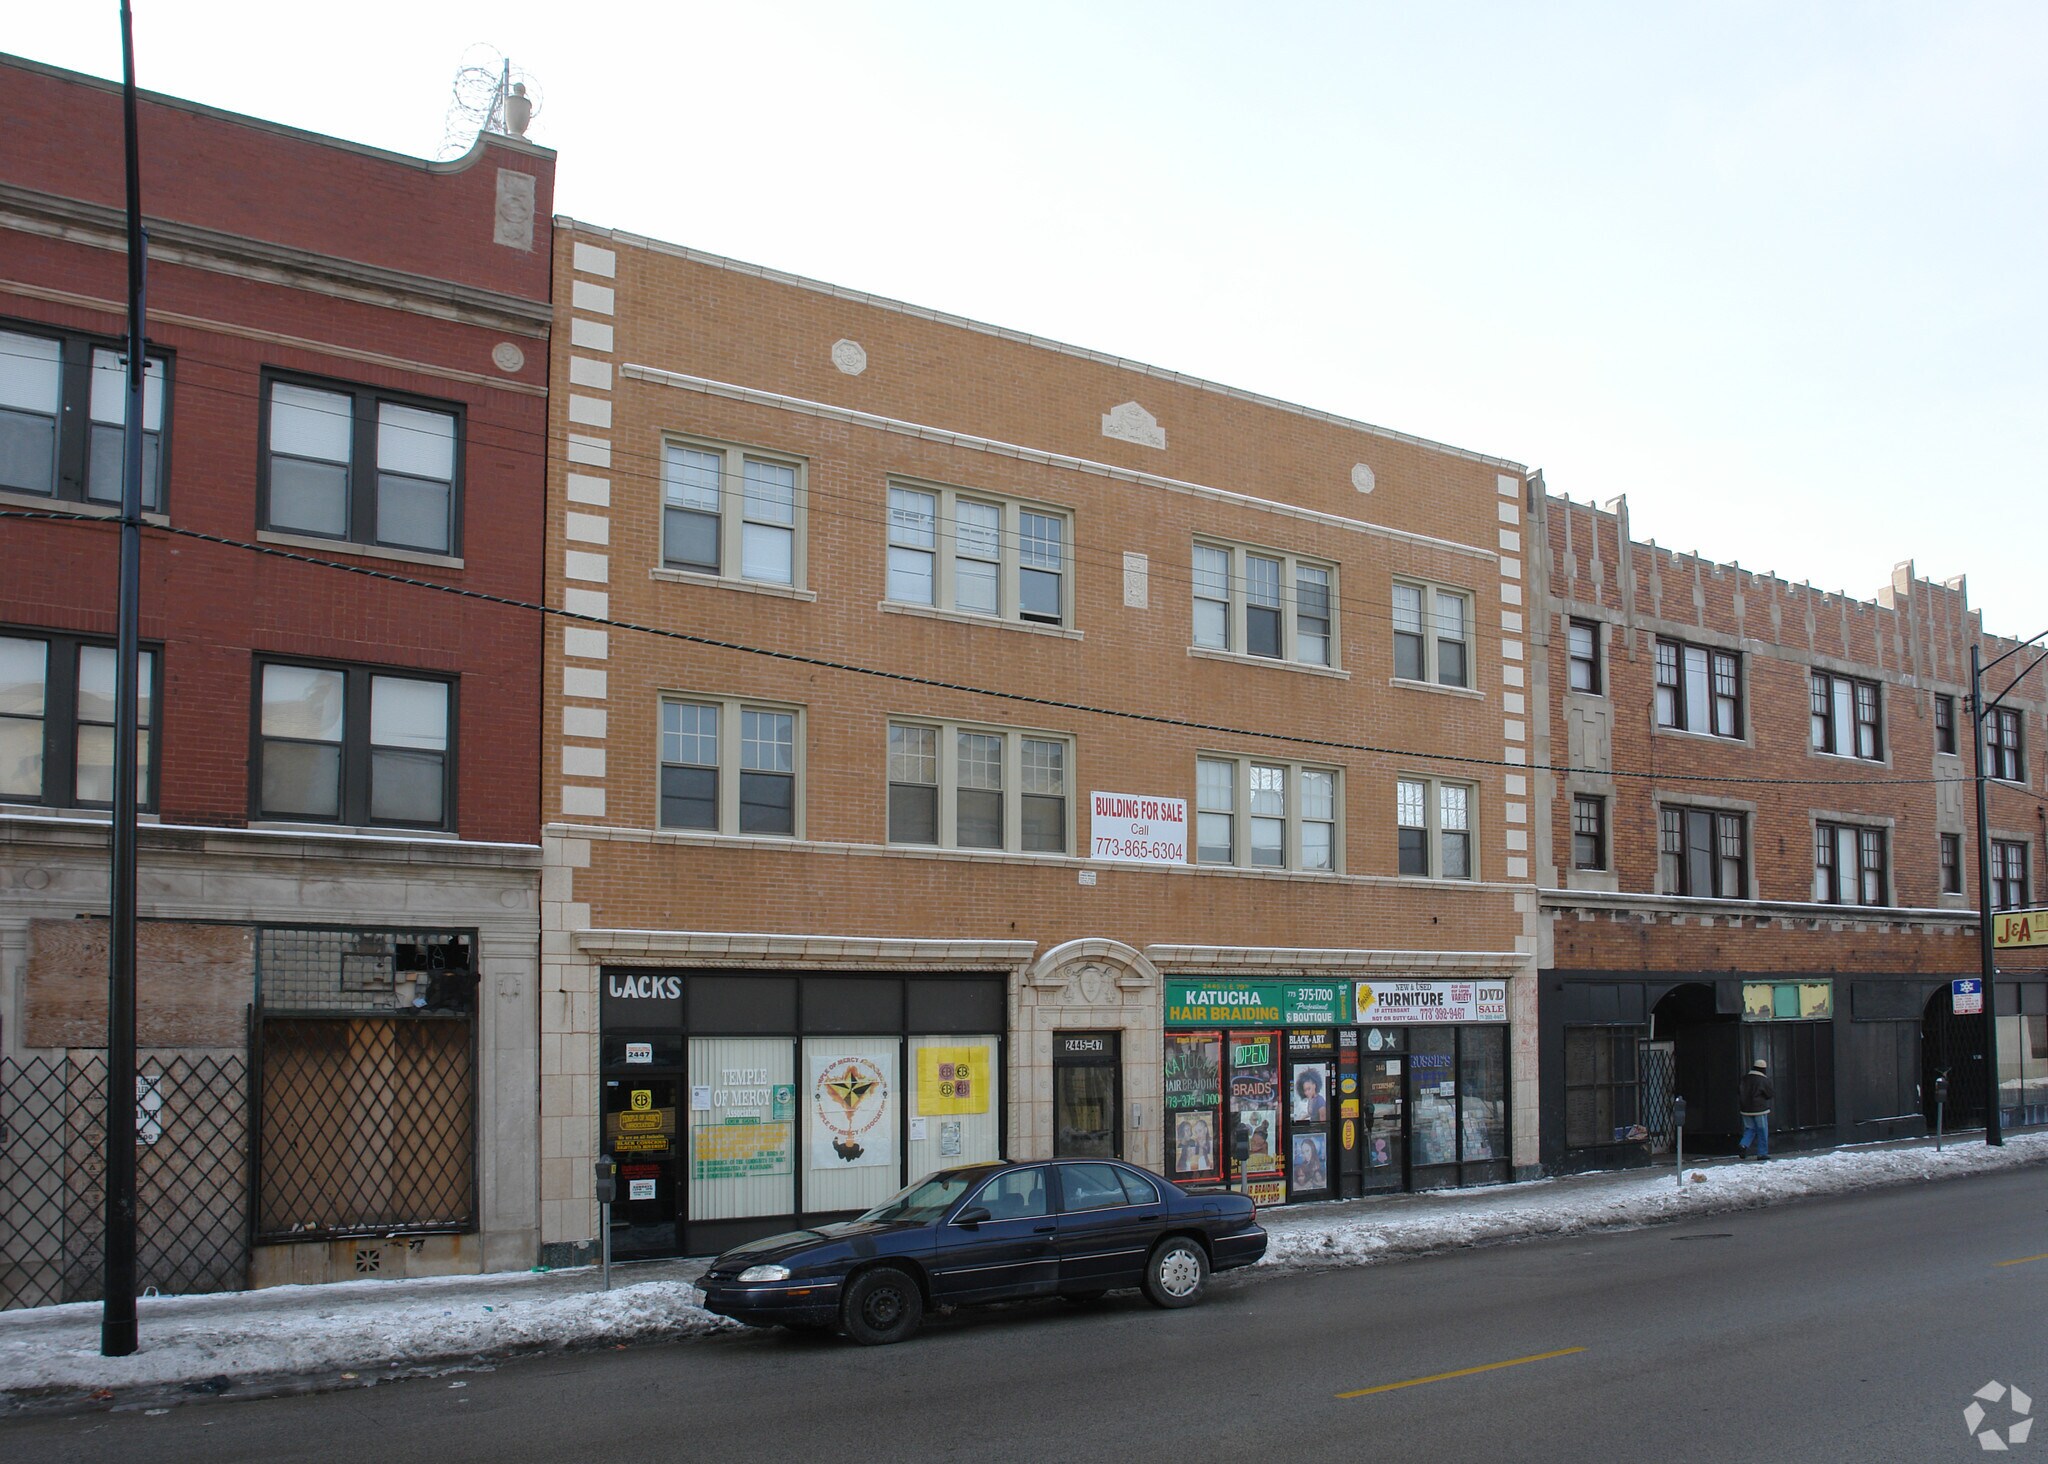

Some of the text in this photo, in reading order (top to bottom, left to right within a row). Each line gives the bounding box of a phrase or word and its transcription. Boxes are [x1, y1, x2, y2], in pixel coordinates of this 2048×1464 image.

[1095, 796, 1183, 823] BUILDING FOR SALE
[1130, 823, 1149, 836] Call
[1096, 837, 1183, 860] 773-865-6304
[609, 975, 682, 999] LACKS
[1186, 991, 1262, 1005] KATUCHA
[1298, 989, 1333, 1001] 375-1700
[1378, 992, 1444, 1007] FURNITURE
[1451, 993, 1472, 1002] VARIETY
[1478, 988, 1504, 1001] DVD
[1169, 1006, 1279, 1021] HAIR BRAIDING
[1435, 1008, 1465, 1020] 392-9467
[1478, 1005, 1504, 1014] SALE
[1294, 1013, 1333, 1023] BOUTIQUE
[1289, 1035, 1325, 1045] BLACK ART
[1236, 1044, 1267, 1065] OPEN
[1164, 1053, 1218, 1078] KATUCHA
[722, 1068, 768, 1086] TEMPLE
[1233, 1082, 1272, 1096] BRAIDS
[714, 1090, 729, 1107] OF
[732, 1088, 772, 1106] MERCY
[1165, 1094, 1220, 1108] 73-375-1700
[726, 1108, 760, 1118] Association
[1254, 1183, 1280, 1194] BRAIDING
